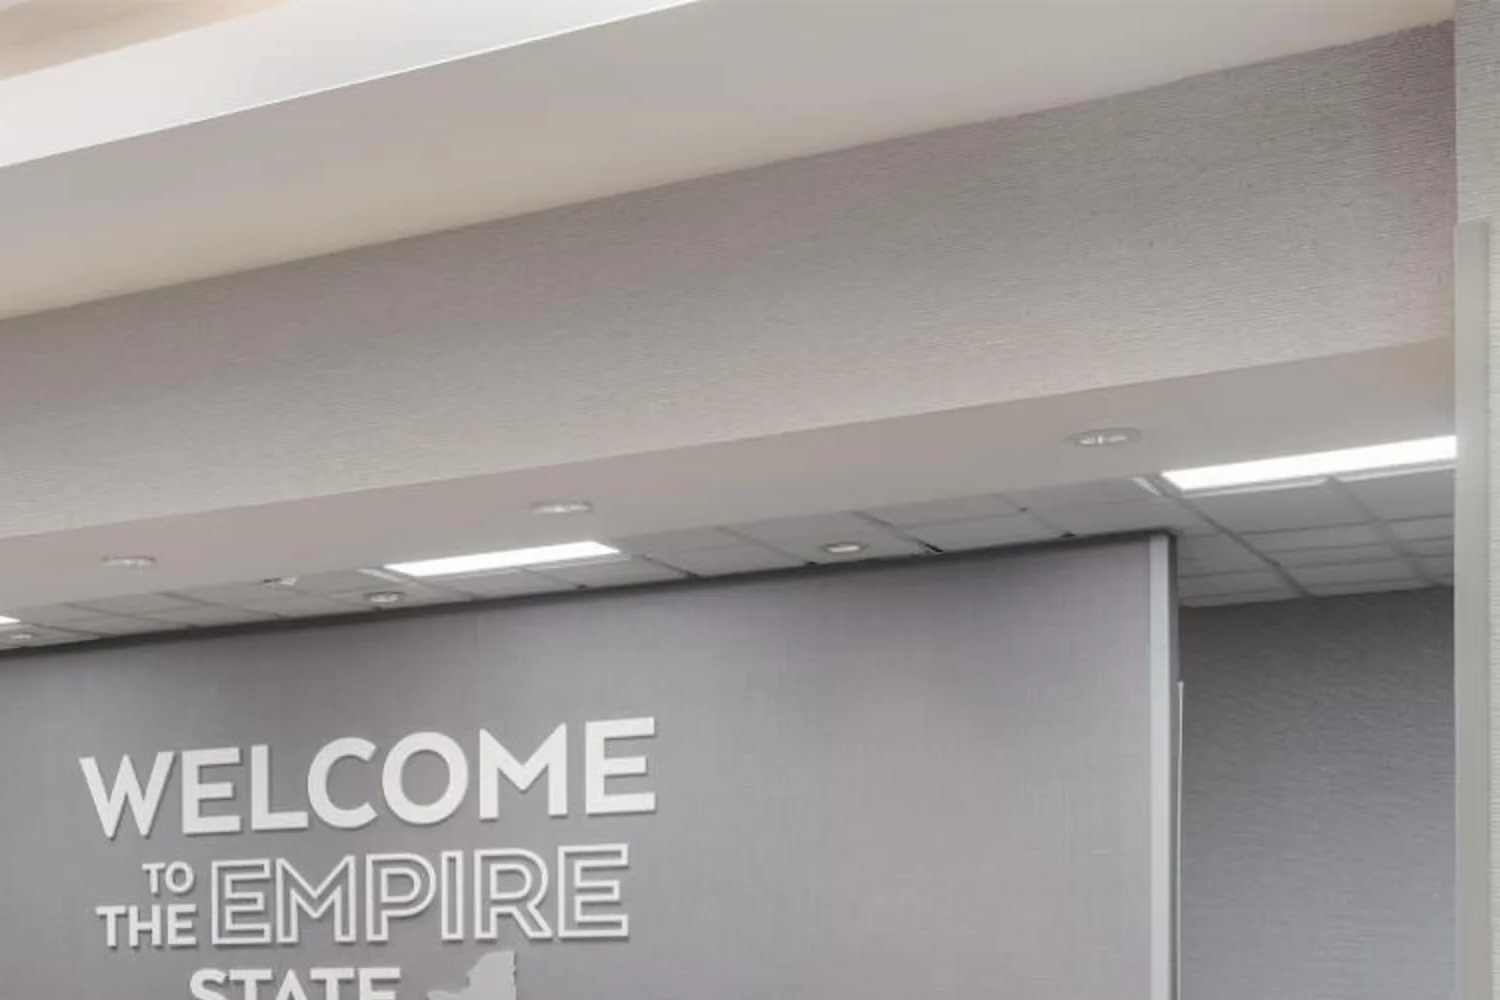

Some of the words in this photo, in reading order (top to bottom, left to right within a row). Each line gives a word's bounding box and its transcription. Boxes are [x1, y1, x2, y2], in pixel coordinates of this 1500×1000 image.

[79, 717, 656, 839] WELCOME
[96, 904, 198, 947] THE
[211, 843, 630, 945] EMPIRE
[142, 861, 195, 894] TO
